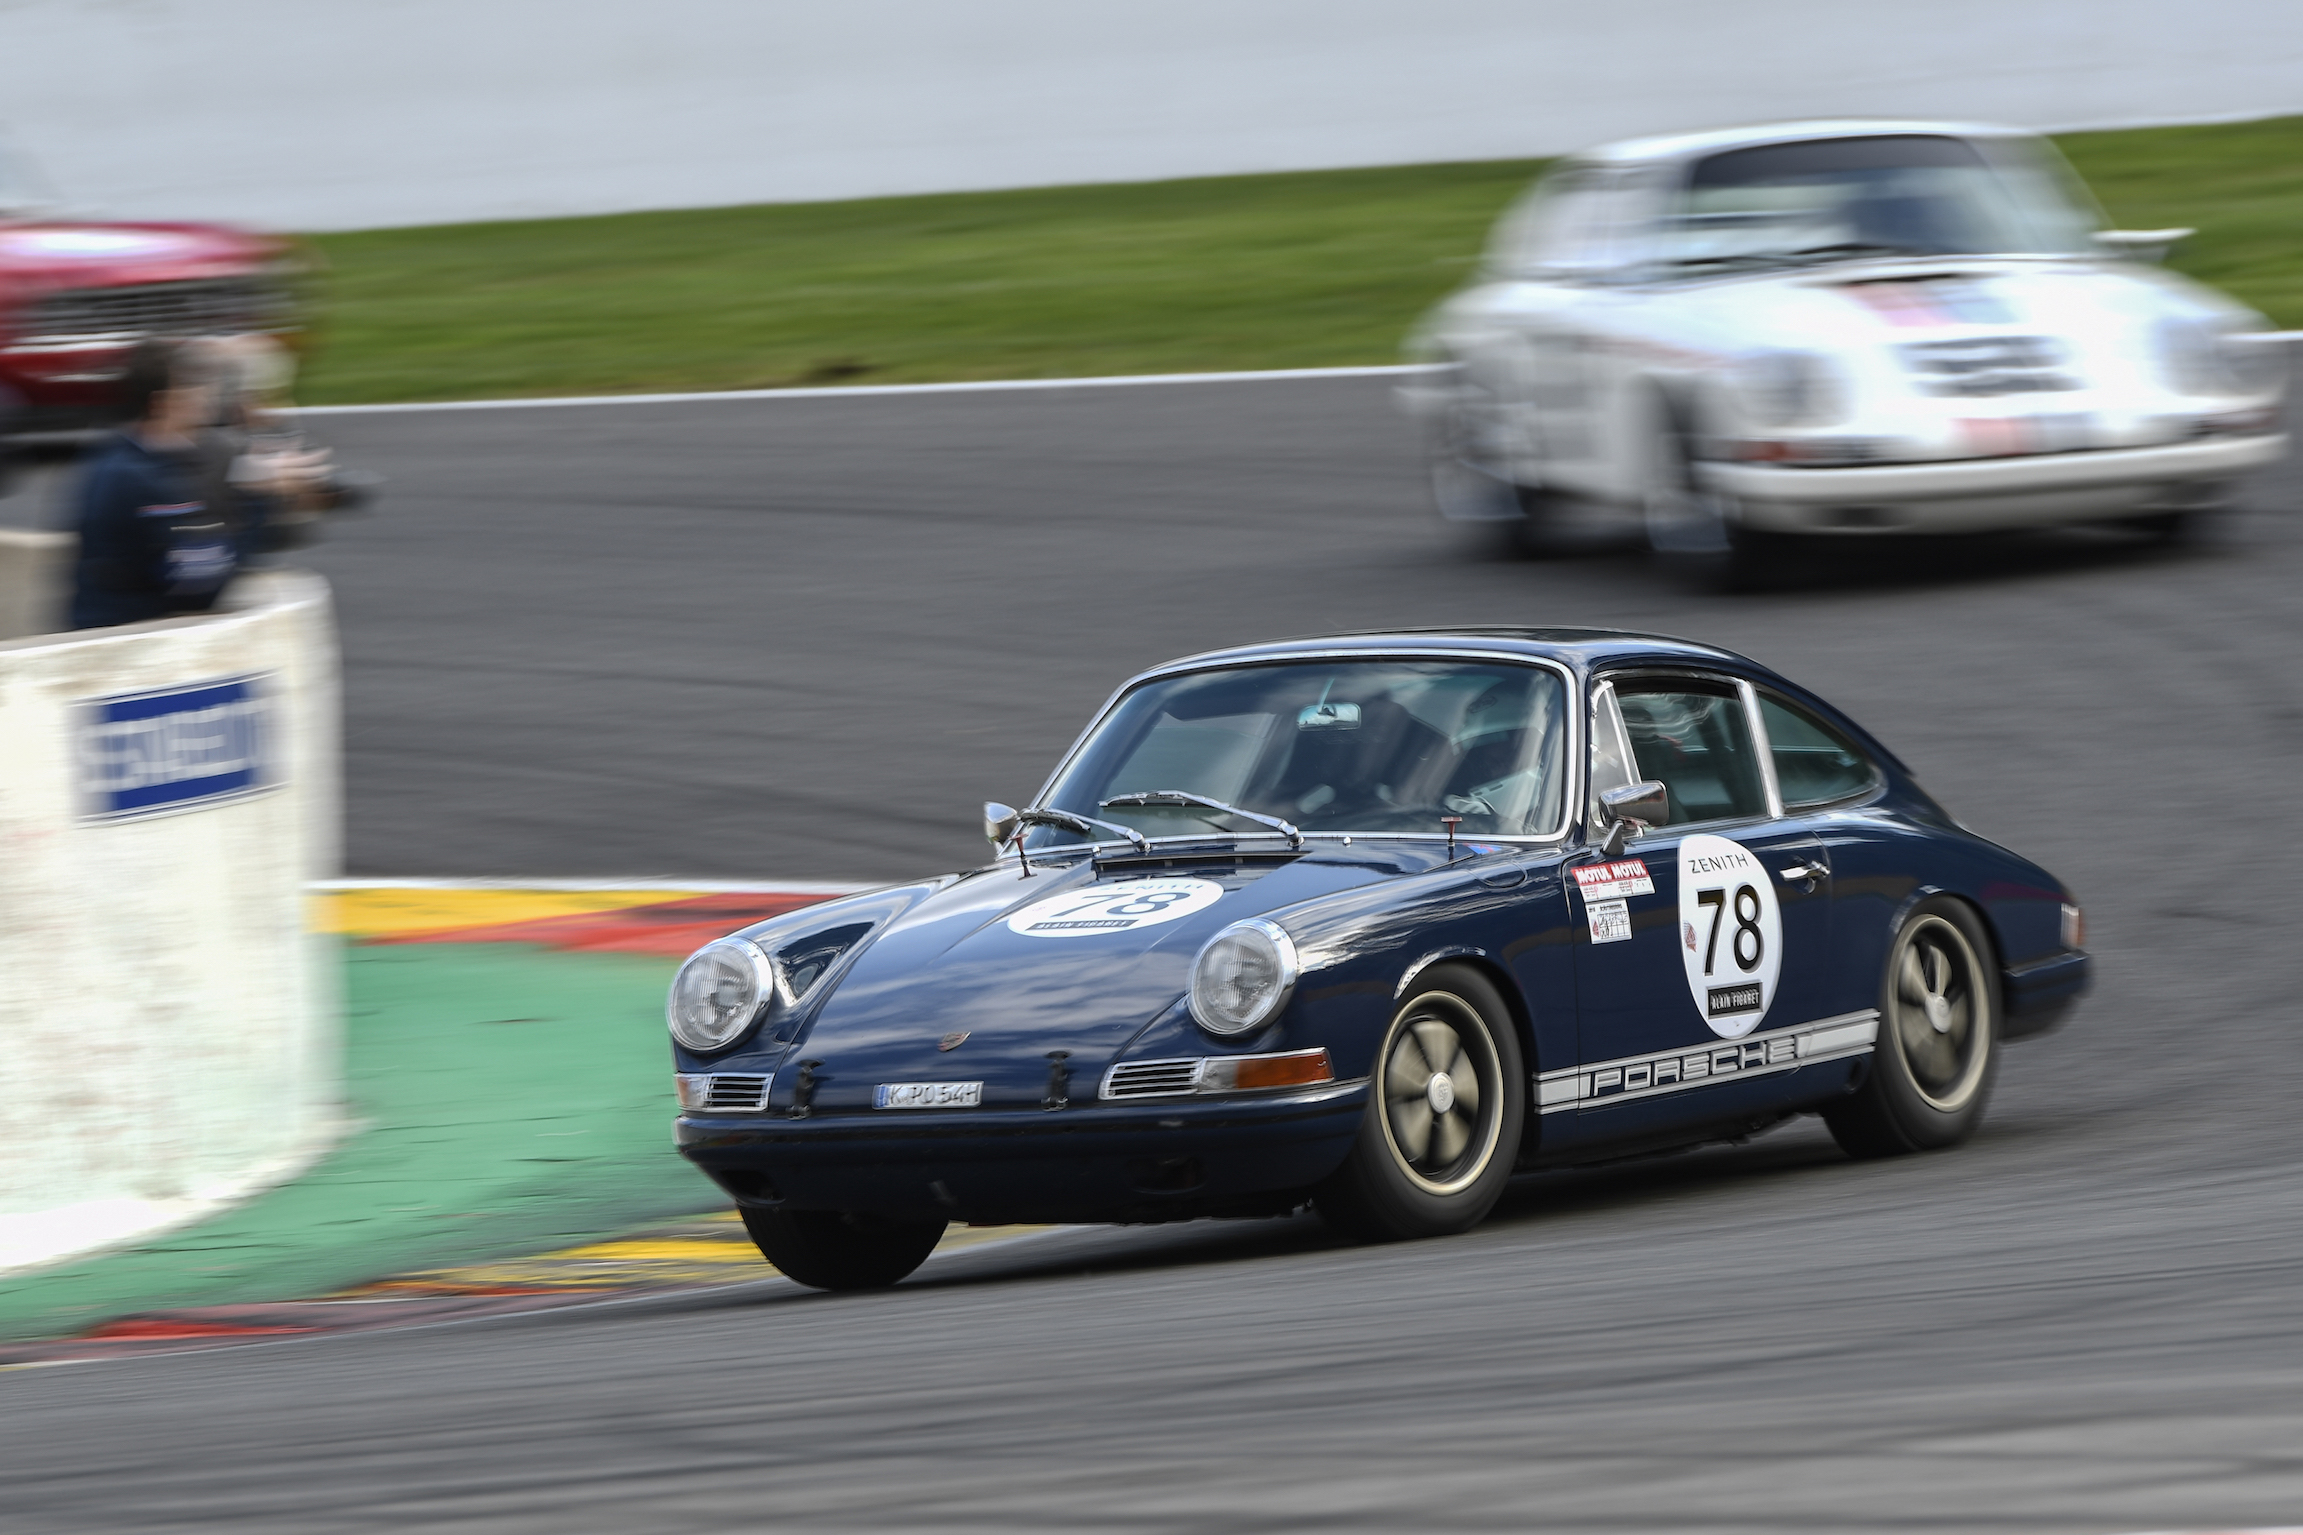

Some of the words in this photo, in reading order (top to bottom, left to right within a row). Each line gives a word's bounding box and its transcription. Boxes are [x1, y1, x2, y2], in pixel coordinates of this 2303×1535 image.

[1575, 866, 1612, 884] MOTUL
[1611, 861, 1647, 879] MOTUL
[1688, 853, 1749, 874] ZENITH
[1048, 891, 1191, 918] 78
[1697, 884, 1763, 975] 78
[1711, 994, 1731, 1010] ALAIN
[1732, 990, 1760, 1007] FIGARET
[1592, 1035, 1796, 1097] PORSCHE
